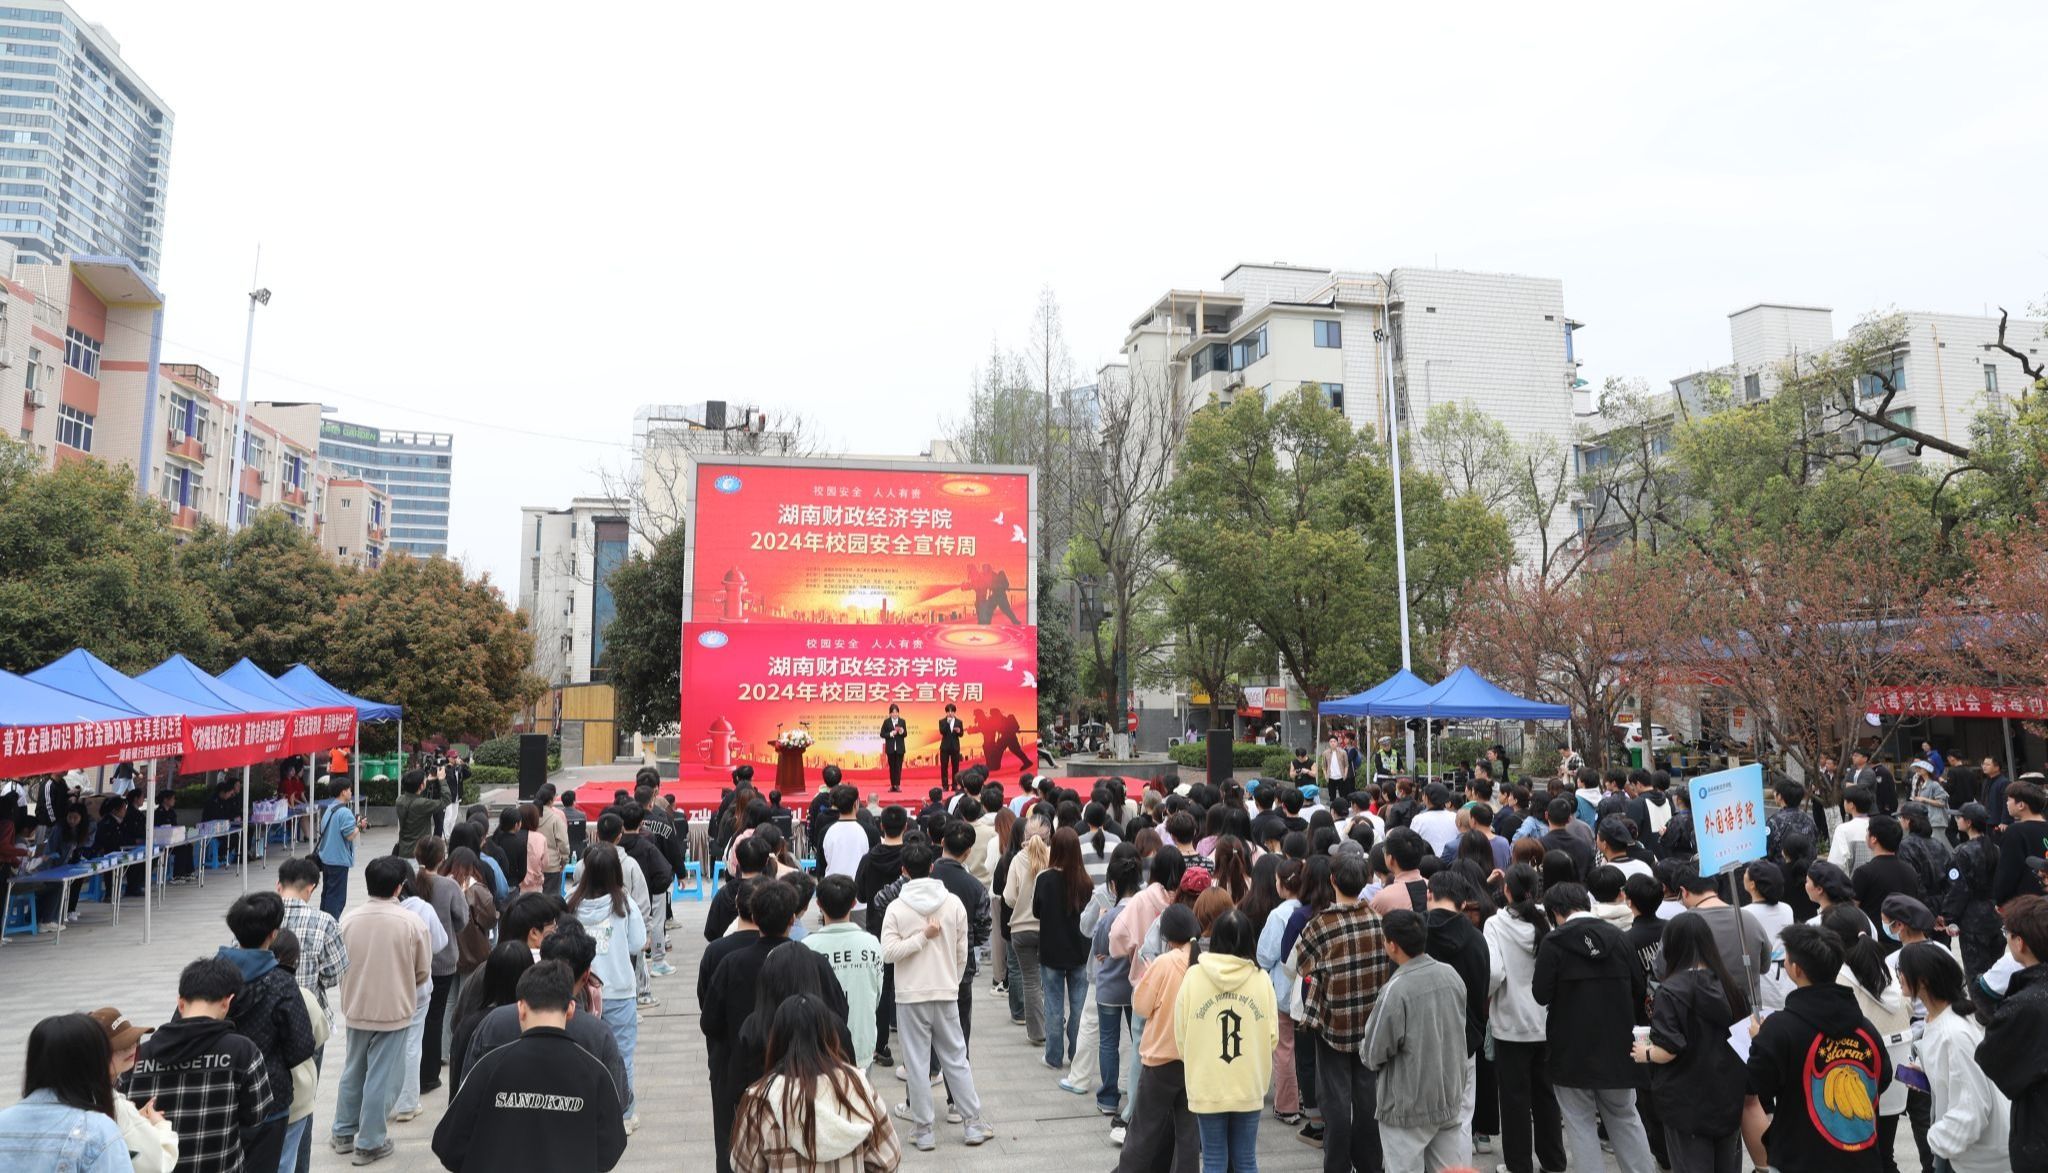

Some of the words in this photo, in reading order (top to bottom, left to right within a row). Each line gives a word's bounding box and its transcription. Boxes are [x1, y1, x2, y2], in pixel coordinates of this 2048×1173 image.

[813, 485, 862, 498] 校园安全
[873, 487, 922, 499] 人人有责
[778, 503, 952, 529] 湖南财政经济学院
[751, 531, 977, 557] 2024年校园安全宣传周
[806, 638, 859, 649] 校园安全
[872, 638, 924, 649] 人人有责
[768, 656, 958, 678] 湖南财政经济学院
[738, 682, 984, 703] 2024年校园安全宣传周
[3, 726, 71, 757] 普及金融知识
[74, 721, 132, 750] 防范金融风险
[134, 717, 182, 743] 共享美好生活
[1705, 800, 1755, 837] 外国语学院
[495, 1091, 584, 1112] SANDKND
